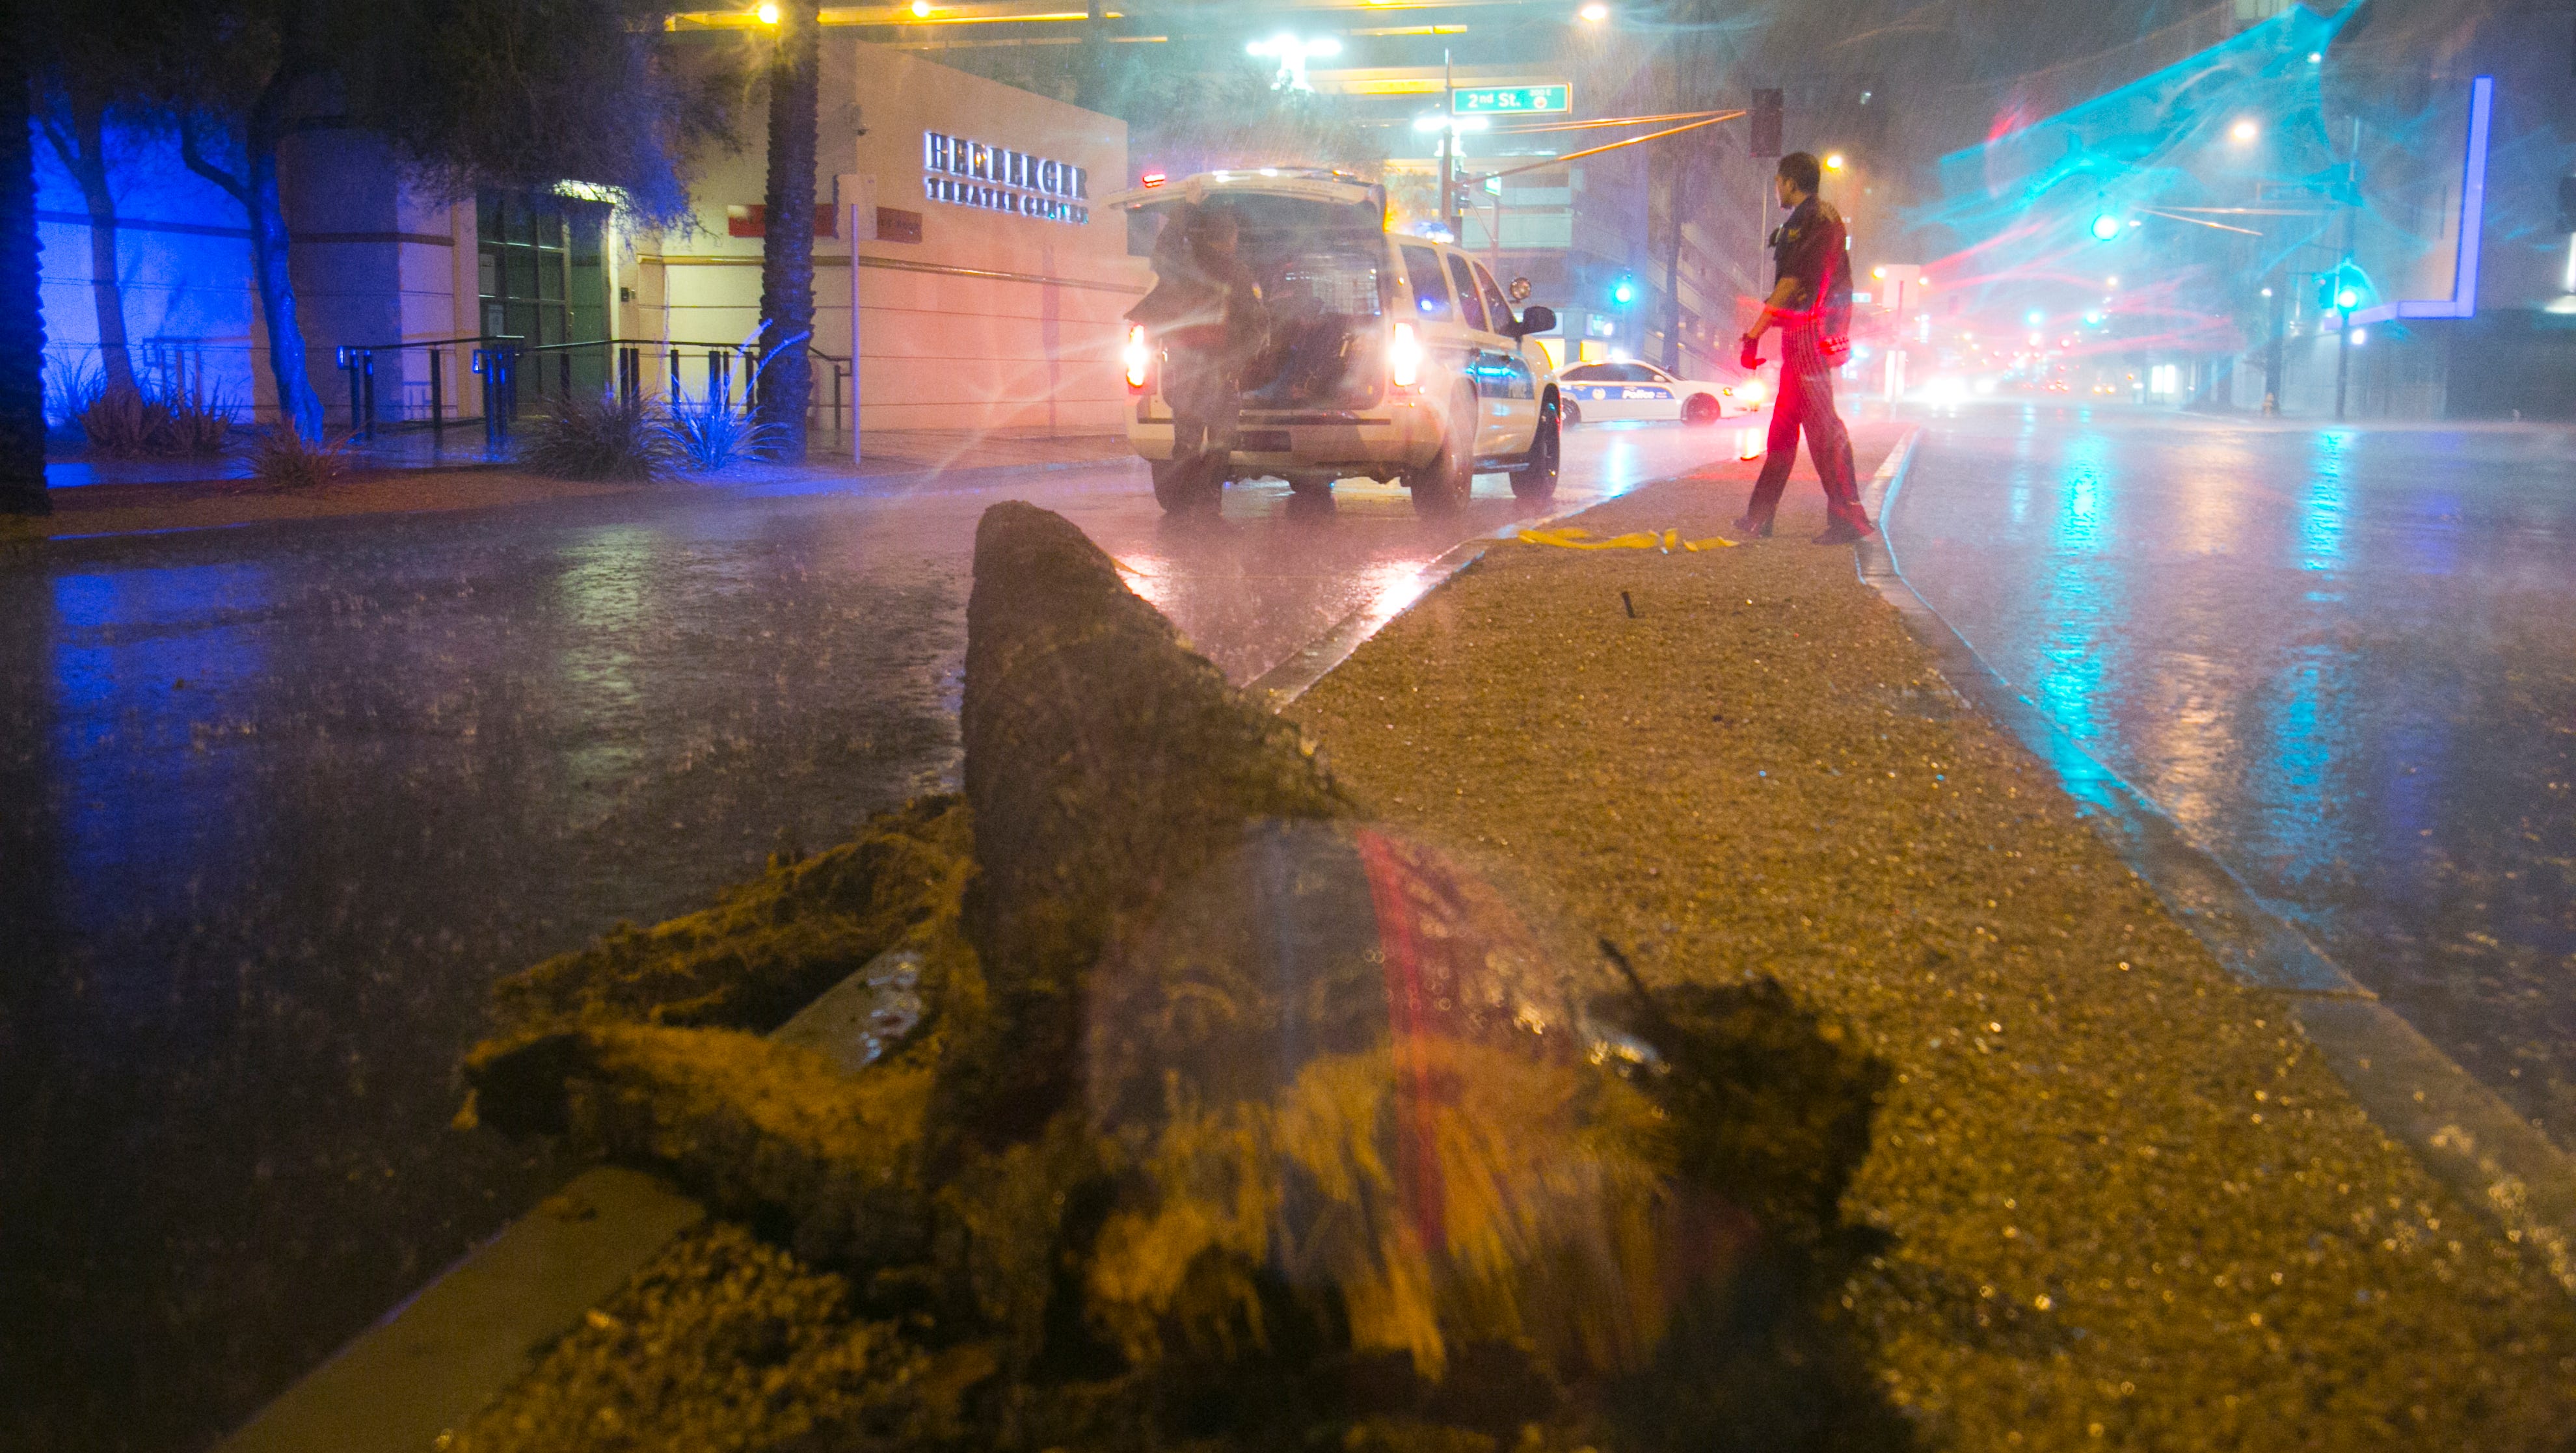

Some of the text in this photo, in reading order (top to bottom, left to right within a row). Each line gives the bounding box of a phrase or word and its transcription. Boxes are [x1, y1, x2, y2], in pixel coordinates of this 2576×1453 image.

[1468, 92, 1521, 108] 2nd St.
[924, 132, 1089, 200] HERBERGER
[924, 177, 1089, 224] THEATER CENTER
[1622, 389, 1655, 399] Police
